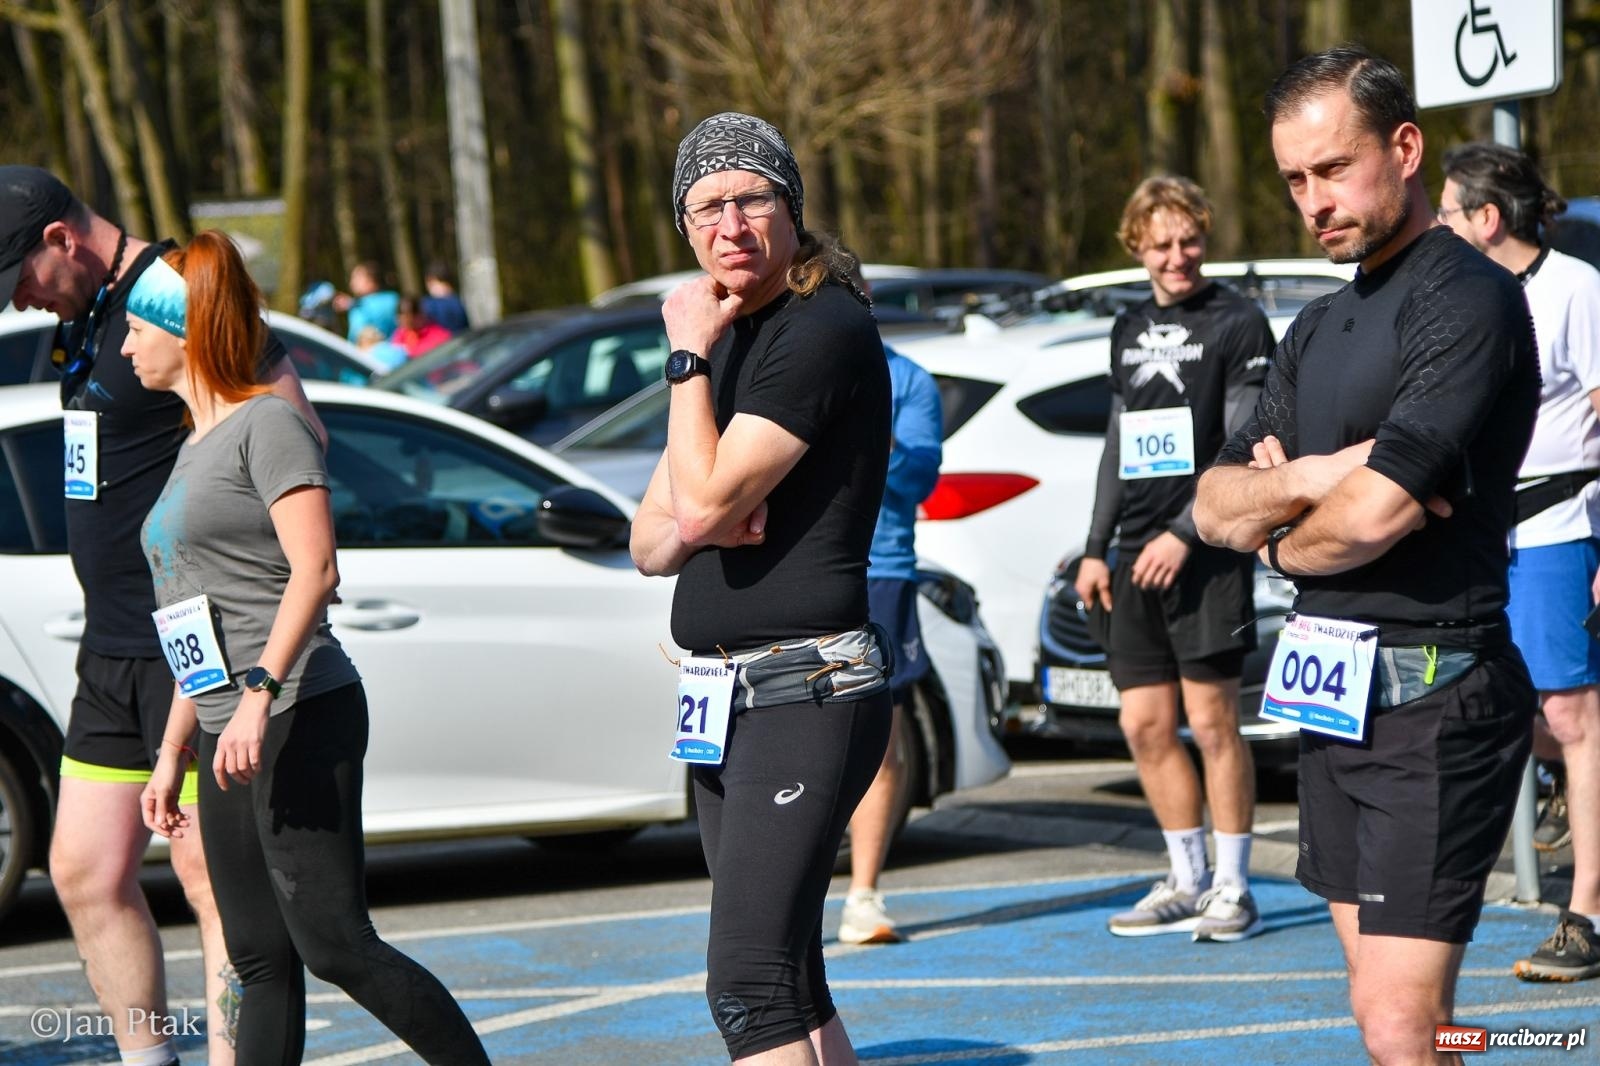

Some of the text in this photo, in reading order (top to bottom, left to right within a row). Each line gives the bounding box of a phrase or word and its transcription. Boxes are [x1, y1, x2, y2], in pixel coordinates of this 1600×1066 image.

[64, 444, 86, 474] 45
[1137, 433, 1176, 457] 106
[168, 633, 204, 672] 038
[1282, 650, 1347, 702] 004
[676, 694, 709, 734] 21
